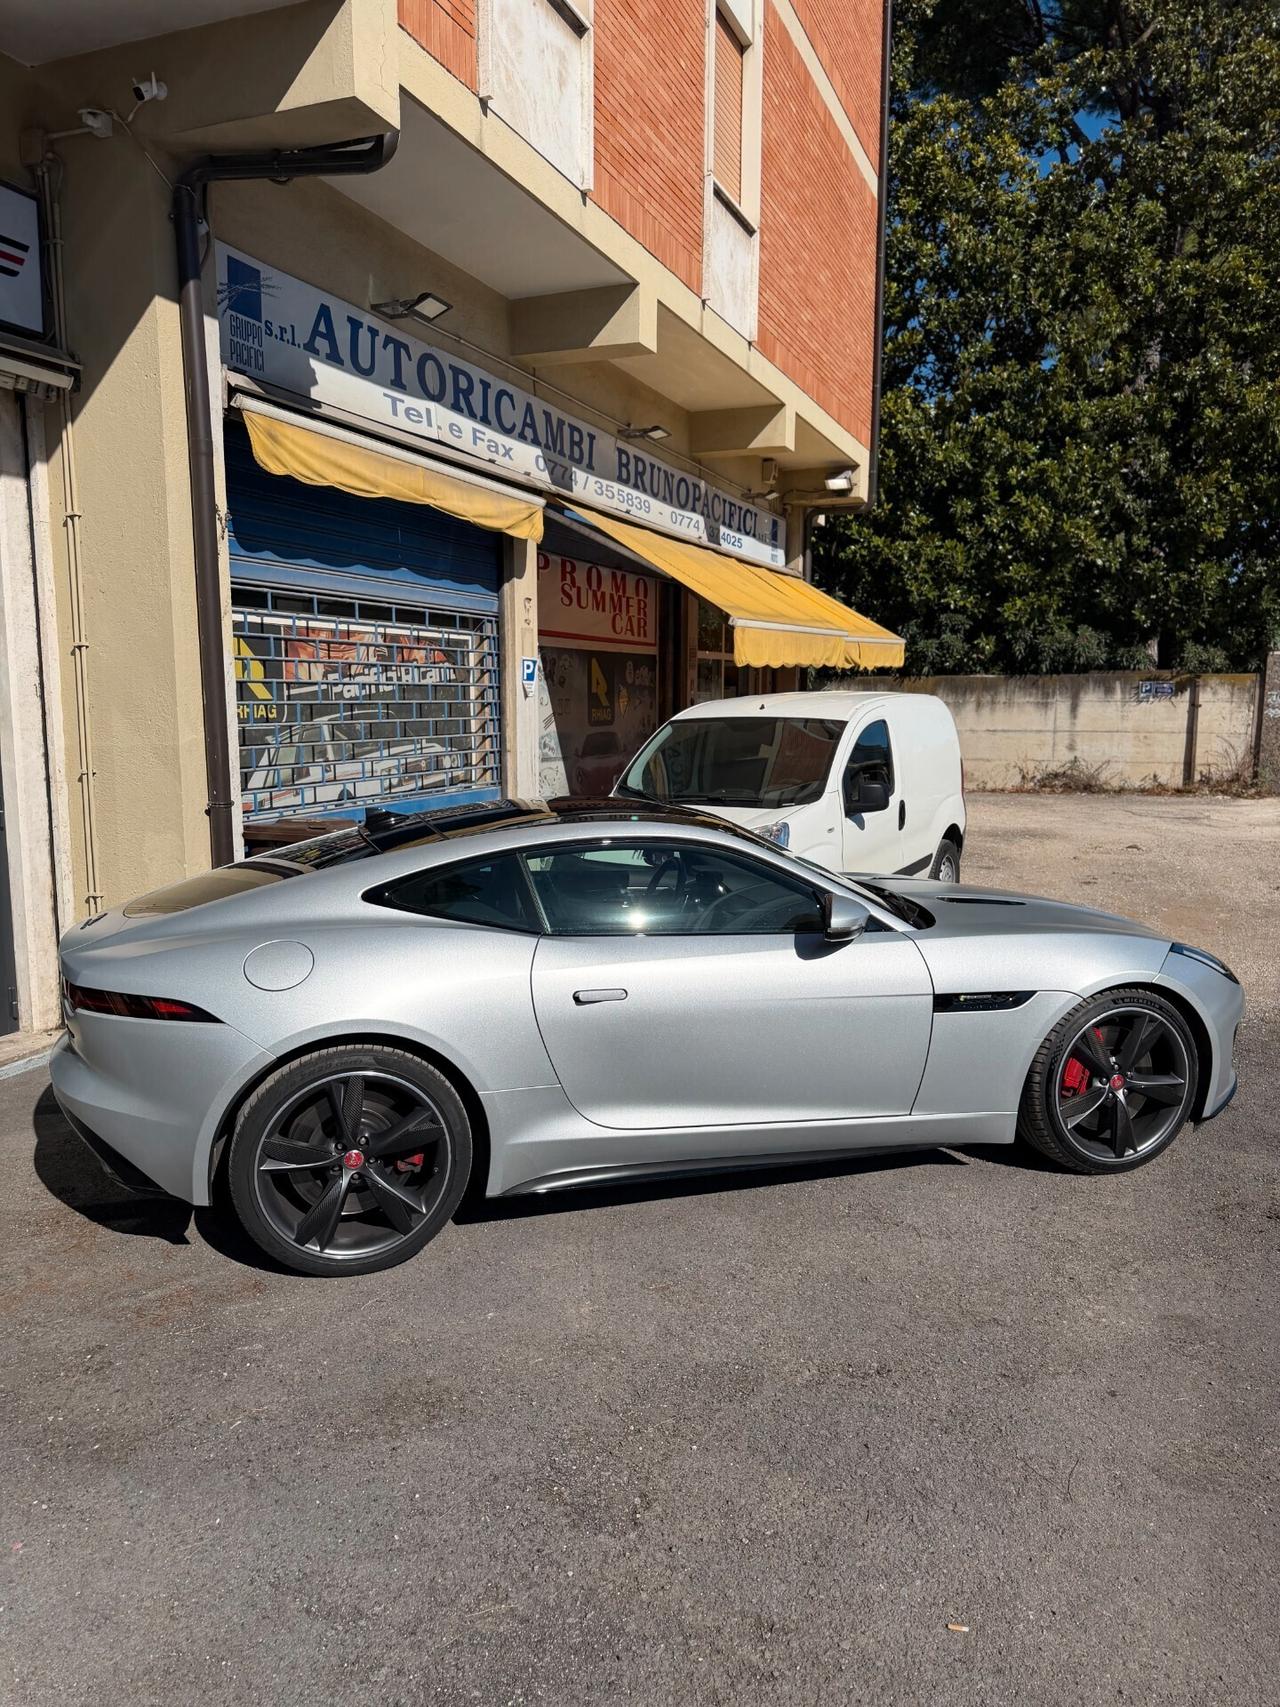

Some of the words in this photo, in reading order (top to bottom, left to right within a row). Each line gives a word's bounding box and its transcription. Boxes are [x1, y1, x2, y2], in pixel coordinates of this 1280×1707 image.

[229, 314, 263, 348] GRUPPO
[229, 338, 265, 372] PACIFICI
[303, 303, 597, 471] AUTORICAMBI
[383, 393, 442, 430] Tel.
[448, 423, 463, 440] e
[471, 427, 514, 461] Fax
[560, 583, 648, 618] SUMMER
[611, 613, 648, 638] CAR
[523, 661, 533, 680] P
[591, 708, 612, 722] RHIAG
